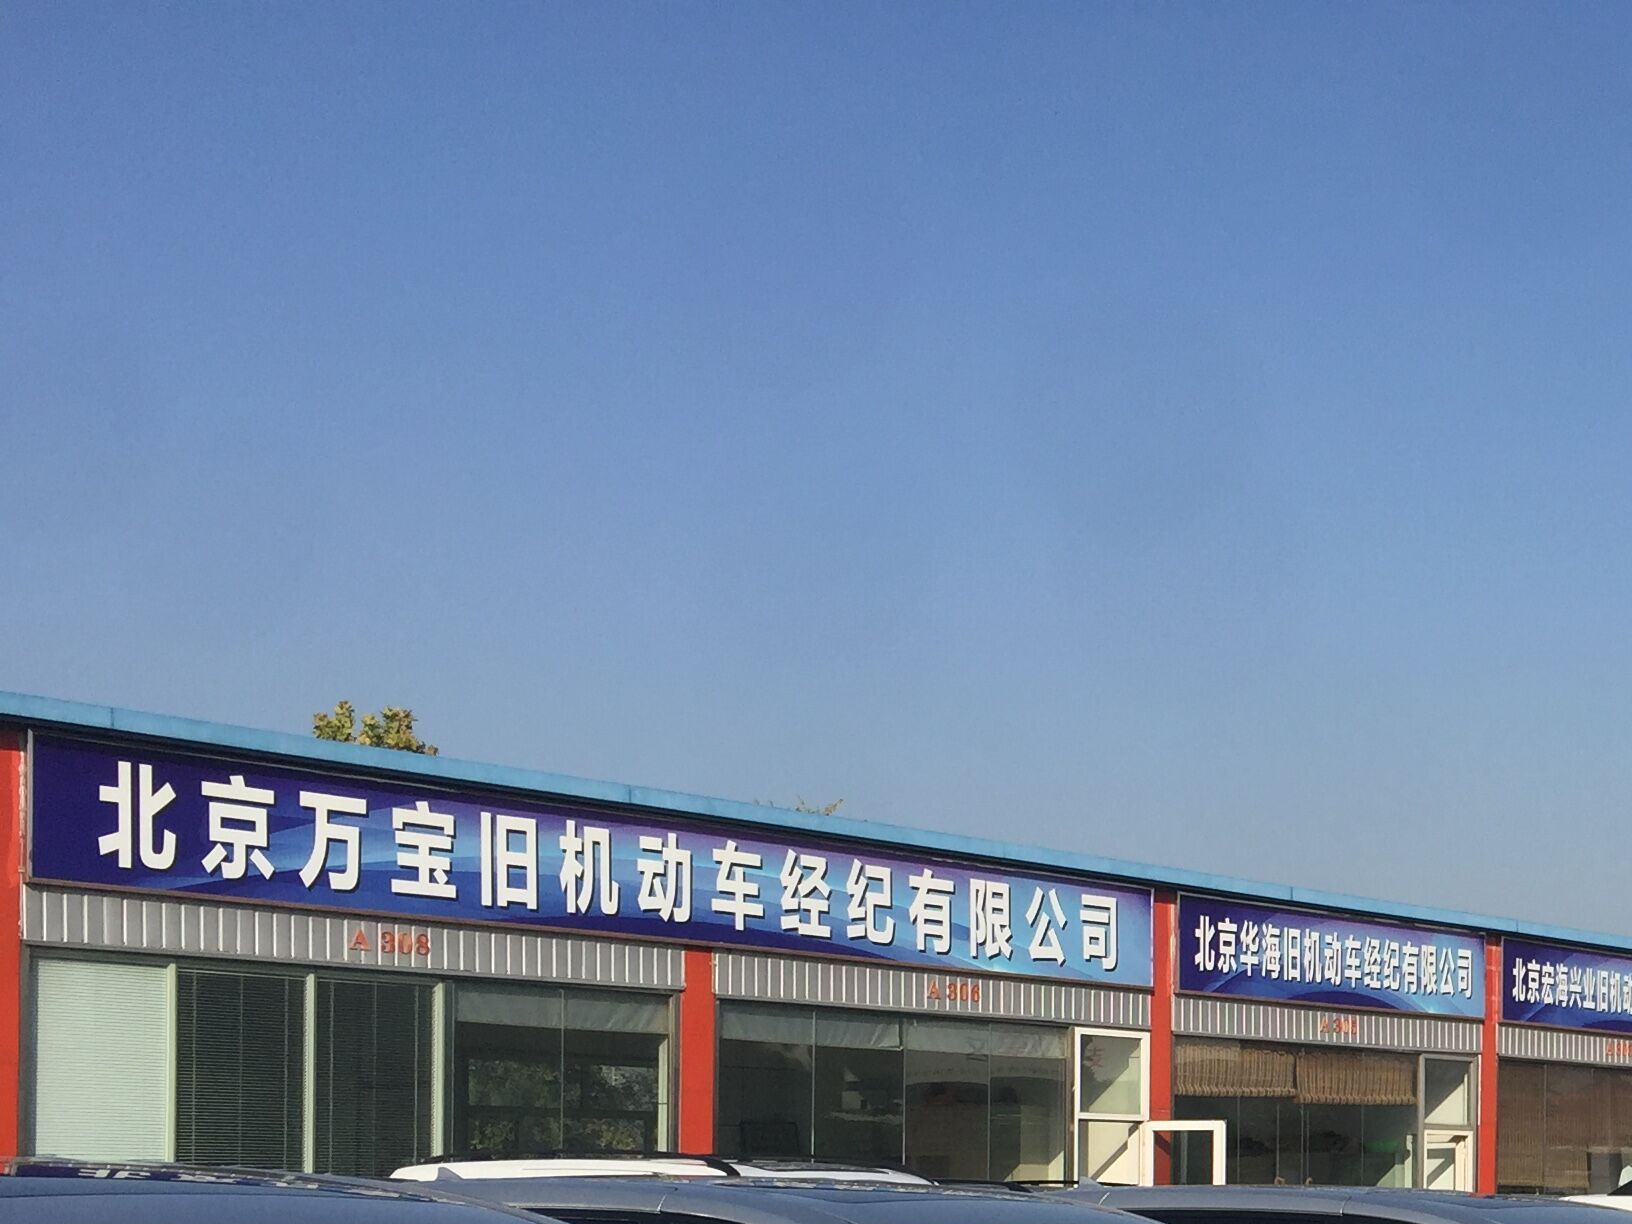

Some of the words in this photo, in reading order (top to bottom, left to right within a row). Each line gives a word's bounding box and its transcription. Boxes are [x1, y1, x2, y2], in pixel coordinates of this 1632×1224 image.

[98, 761, 1119, 970] 北京万宝旧机动车经纪有限公司
[1194, 915, 1473, 999] 北京华海旧机动车经纪有限公司
